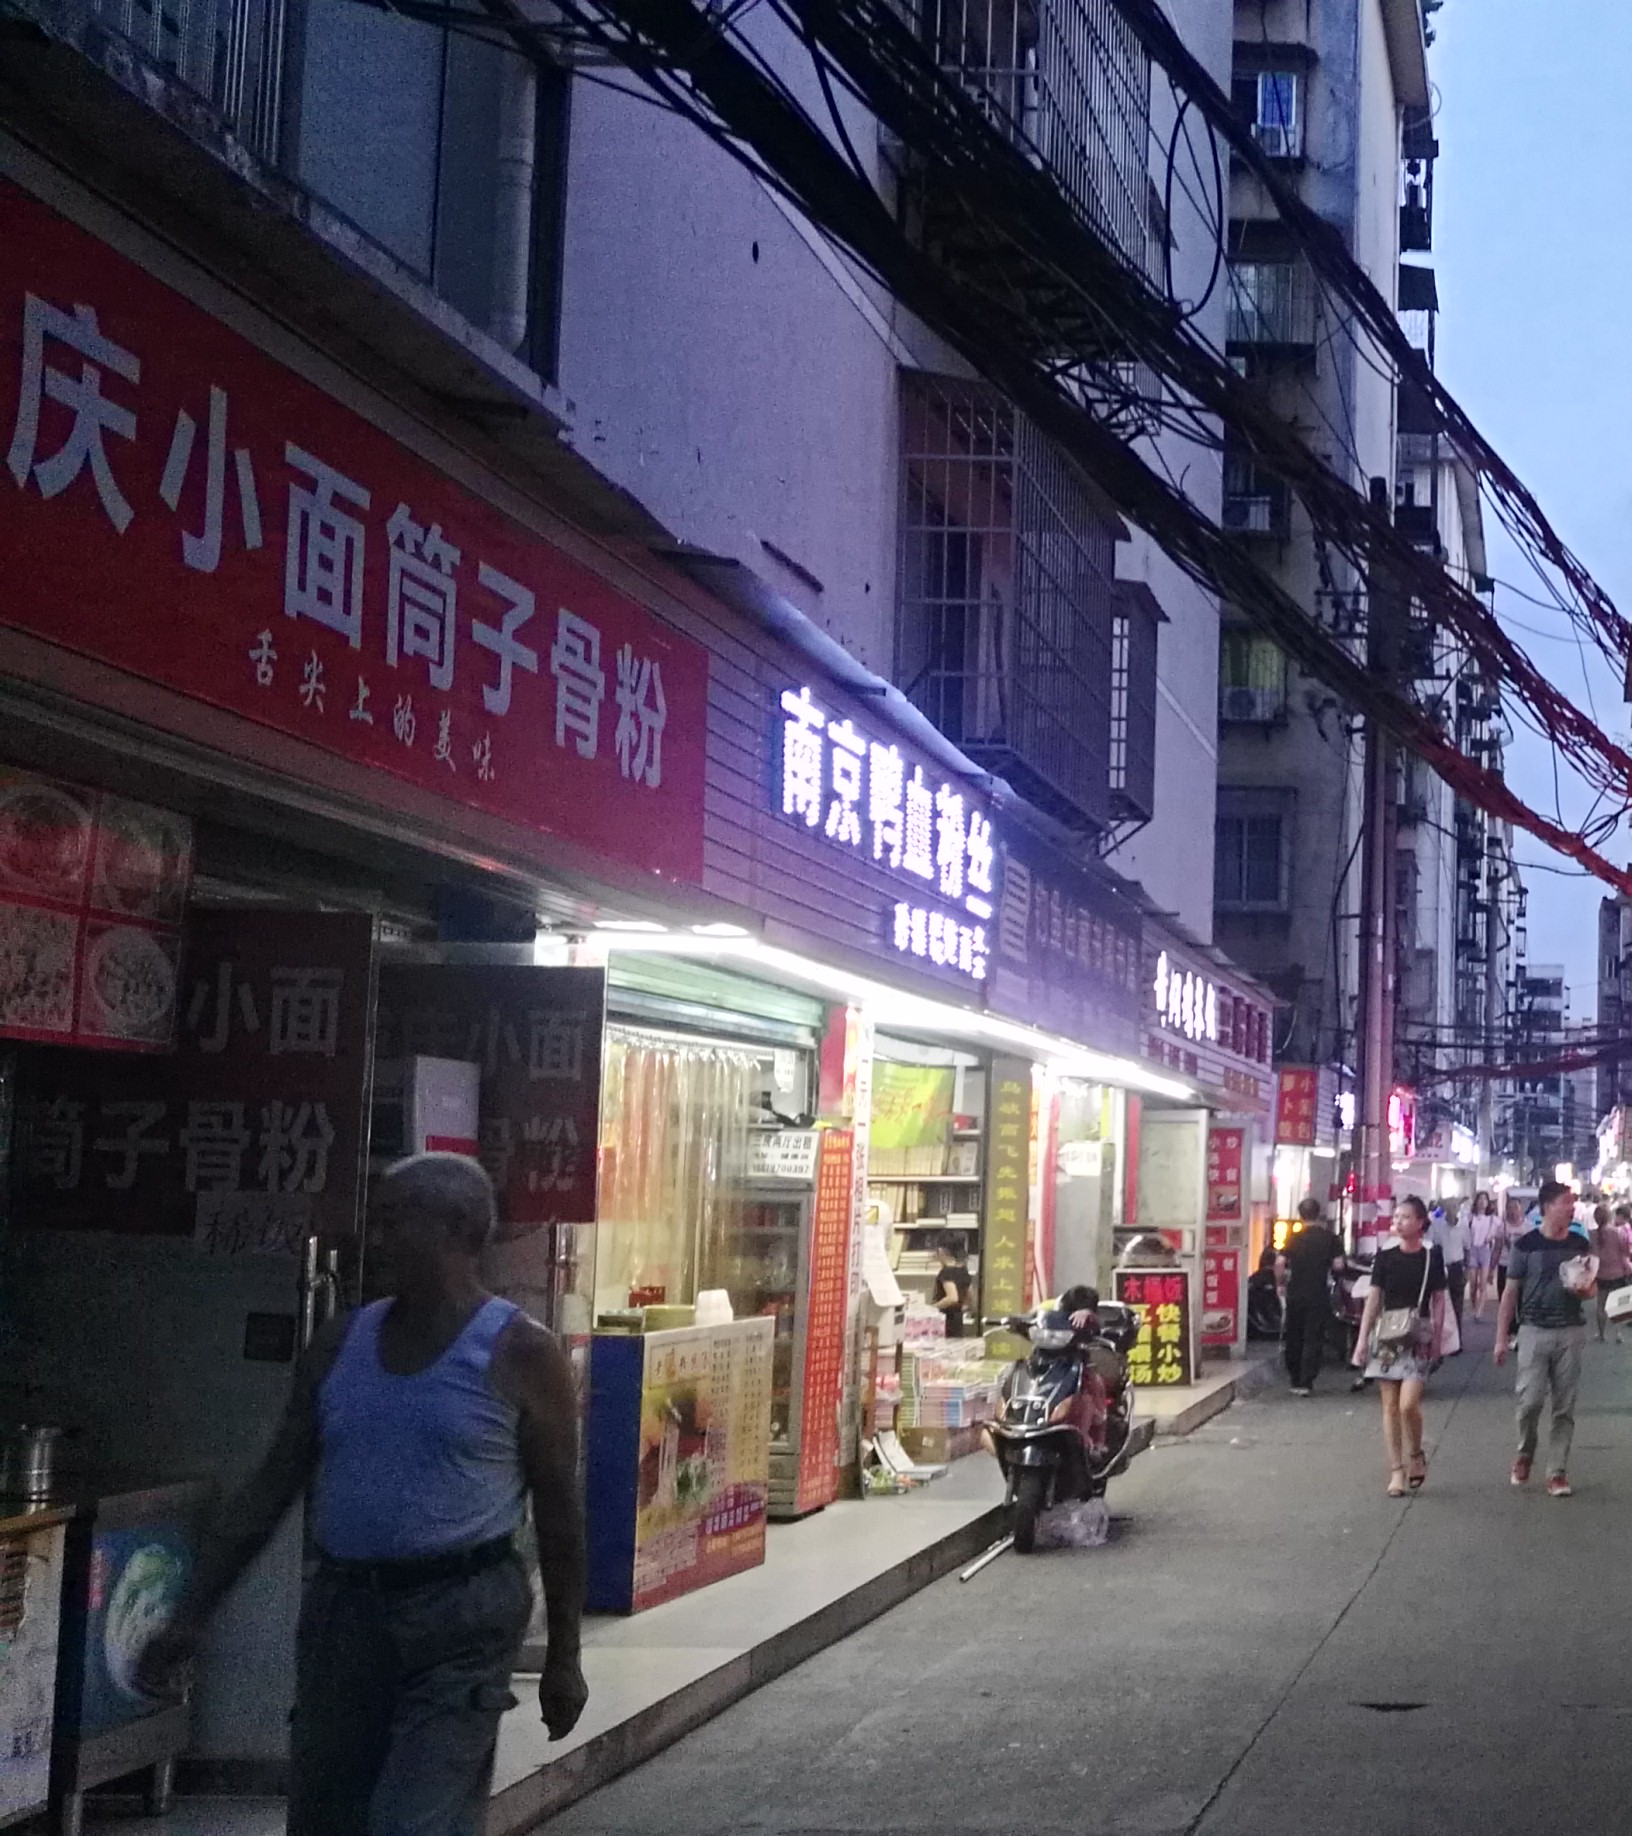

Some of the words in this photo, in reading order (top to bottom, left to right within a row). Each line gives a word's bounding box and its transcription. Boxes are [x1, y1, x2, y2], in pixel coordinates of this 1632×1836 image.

[6, 290, 668, 789] 庆小面筒子骨粉
[248, 628, 497, 782] 舌尖上的美味
[187, 961, 345, 1057] 小面
[1156, 1303, 1183, 1384] 快餐小炒
